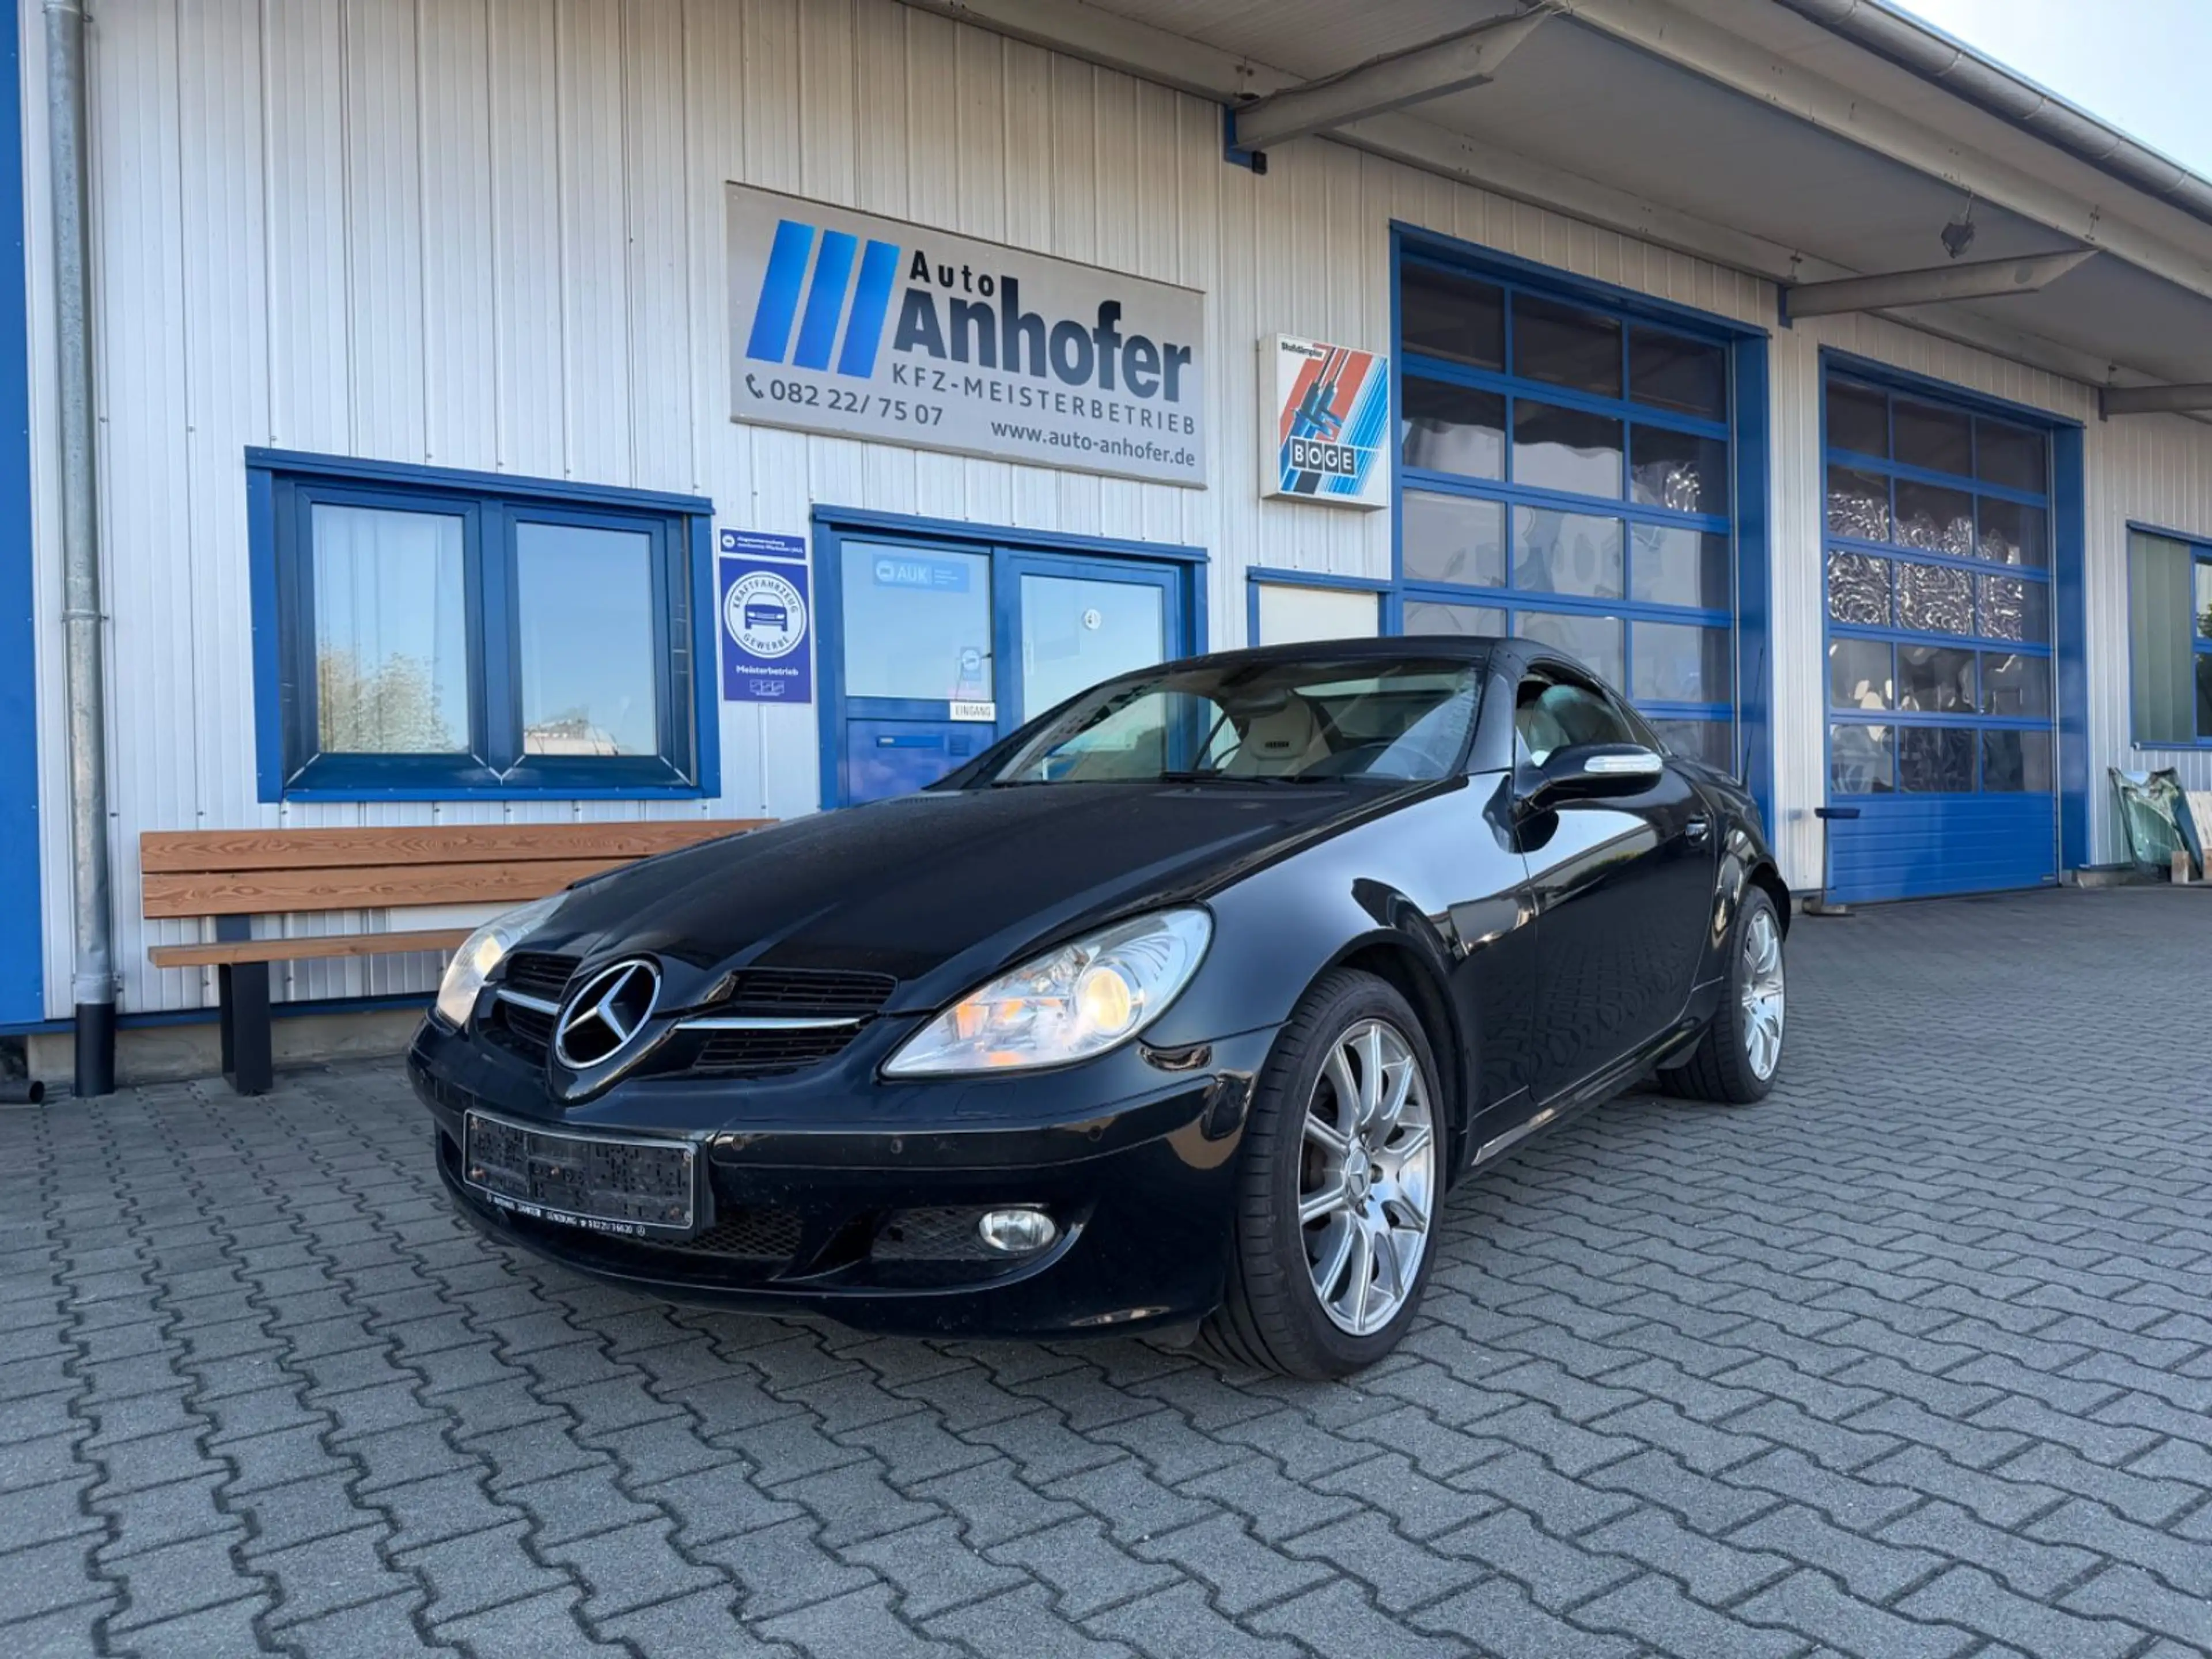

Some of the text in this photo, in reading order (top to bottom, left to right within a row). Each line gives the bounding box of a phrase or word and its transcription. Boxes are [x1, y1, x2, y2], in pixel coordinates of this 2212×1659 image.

[910, 249, 995, 297] Auto
[893, 275, 1192, 403] Anhofer
[892, 362, 1195, 435] KFZ-MEISTERBETRIEB
[991, 421, 1195, 468] www.auto-anhofer.de
[1294, 445, 1352, 470] BOGE
[733, 579, 798, 613] KRAFTFAHRZEUG
[743, 633, 789, 650] GEWERBE
[736, 665, 798, 676] Meisterbetrieb
[955, 704, 991, 717] EINGANG
